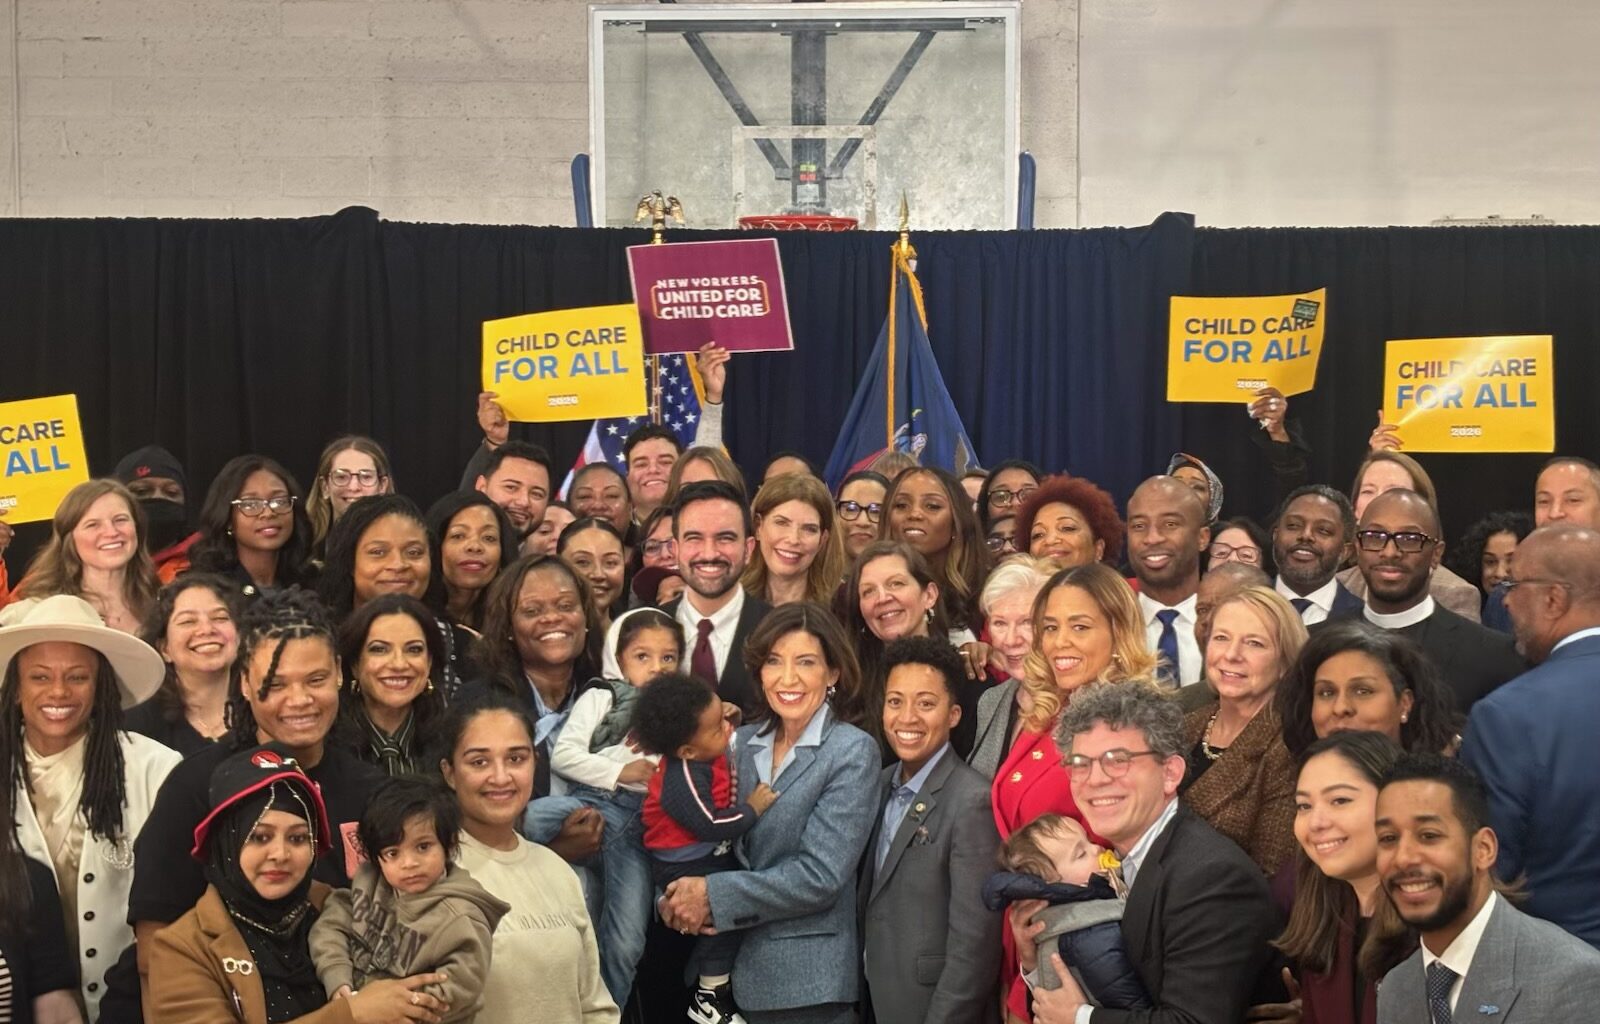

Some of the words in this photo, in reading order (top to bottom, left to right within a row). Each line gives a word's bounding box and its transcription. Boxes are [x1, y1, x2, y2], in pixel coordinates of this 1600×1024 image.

[656, 278, 689, 289] NEW
[691, 275, 759, 287] YORKERS
[658, 289, 723, 304] UNITED
[724, 288, 762, 302] FOR
[660, 305, 714, 319] CHILD
[715, 303, 764, 318] CARE
[1185, 318, 1256, 335] CHILD
[496, 332, 560, 355] CHILD
[566, 327, 627, 347] CARE
[1184, 339, 1252, 363] FOR
[1261, 334, 1311, 363] ALL
[495, 355, 559, 384] FOR
[569, 350, 628, 377] ALL
[1396, 384, 1463, 409] FOR
[1473, 383, 1537, 408] ALL
[0, 420, 65, 444] CARE
[1450, 427, 1482, 437] 2026
[5, 445, 70, 477] ALL
